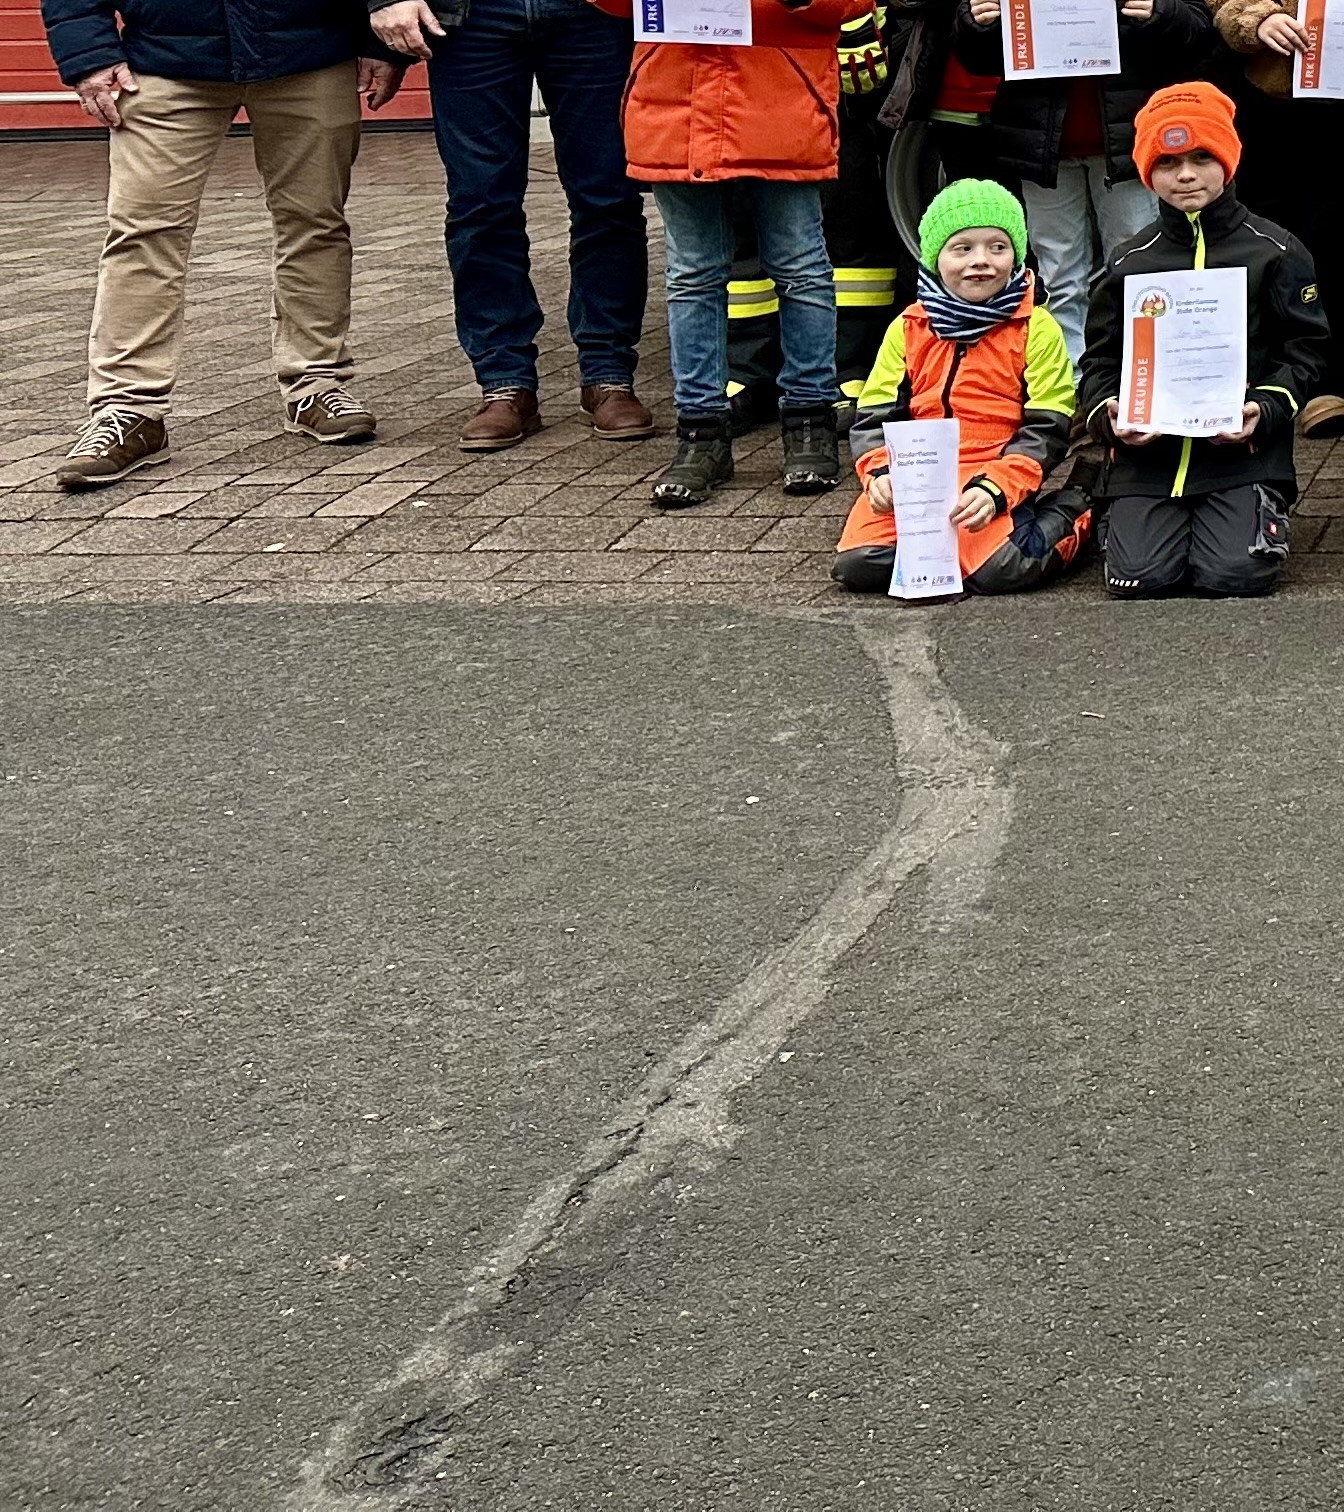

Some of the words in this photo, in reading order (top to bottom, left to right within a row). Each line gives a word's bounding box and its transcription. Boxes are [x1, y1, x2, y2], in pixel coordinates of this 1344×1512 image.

[1014, 3, 1029, 70] URKUNDE
[1304, 25, 1319, 89] URKUNDE
[1133, 357, 1149, 425] URKUNDE
